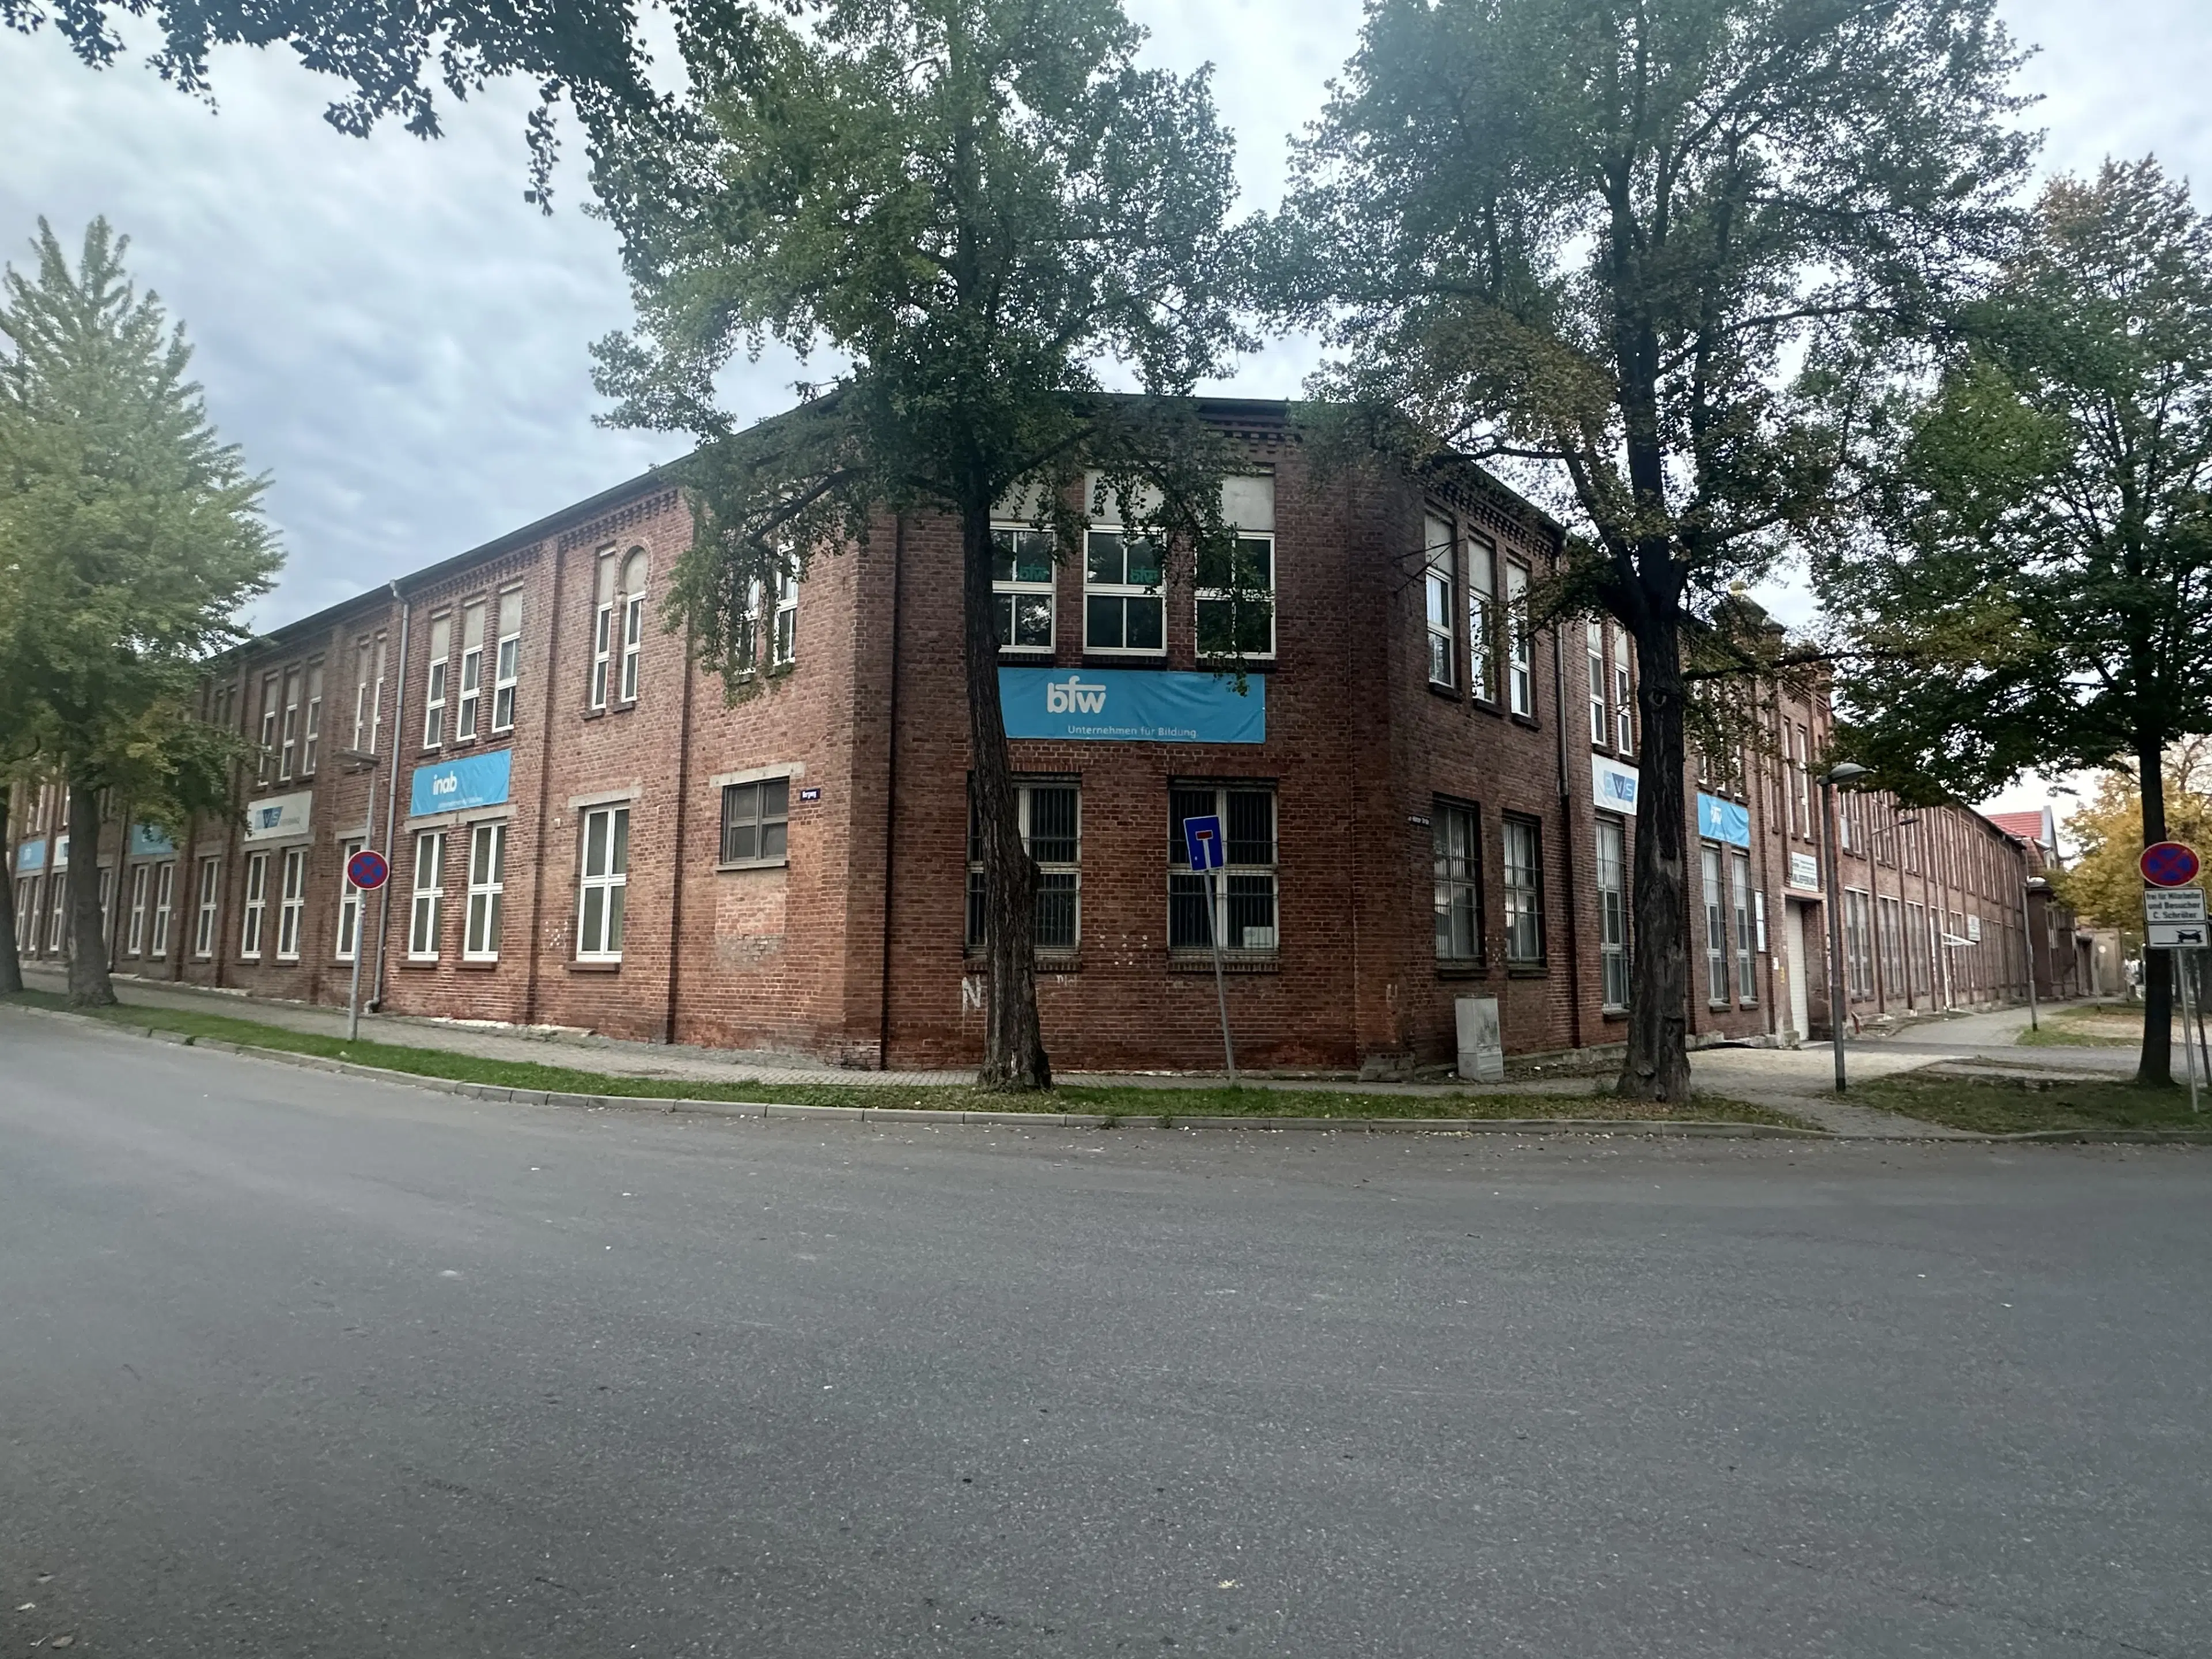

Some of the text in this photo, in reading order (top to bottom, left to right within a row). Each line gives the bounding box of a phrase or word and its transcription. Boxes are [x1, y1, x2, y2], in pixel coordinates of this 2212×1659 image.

[1047, 675, 1107, 714] bfw
[1068, 725, 1138, 736] Unternehmen
[1141, 726, 1155, 736] für
[433, 770, 458, 796] inab
[2164, 901, 2200, 909] Besucher
